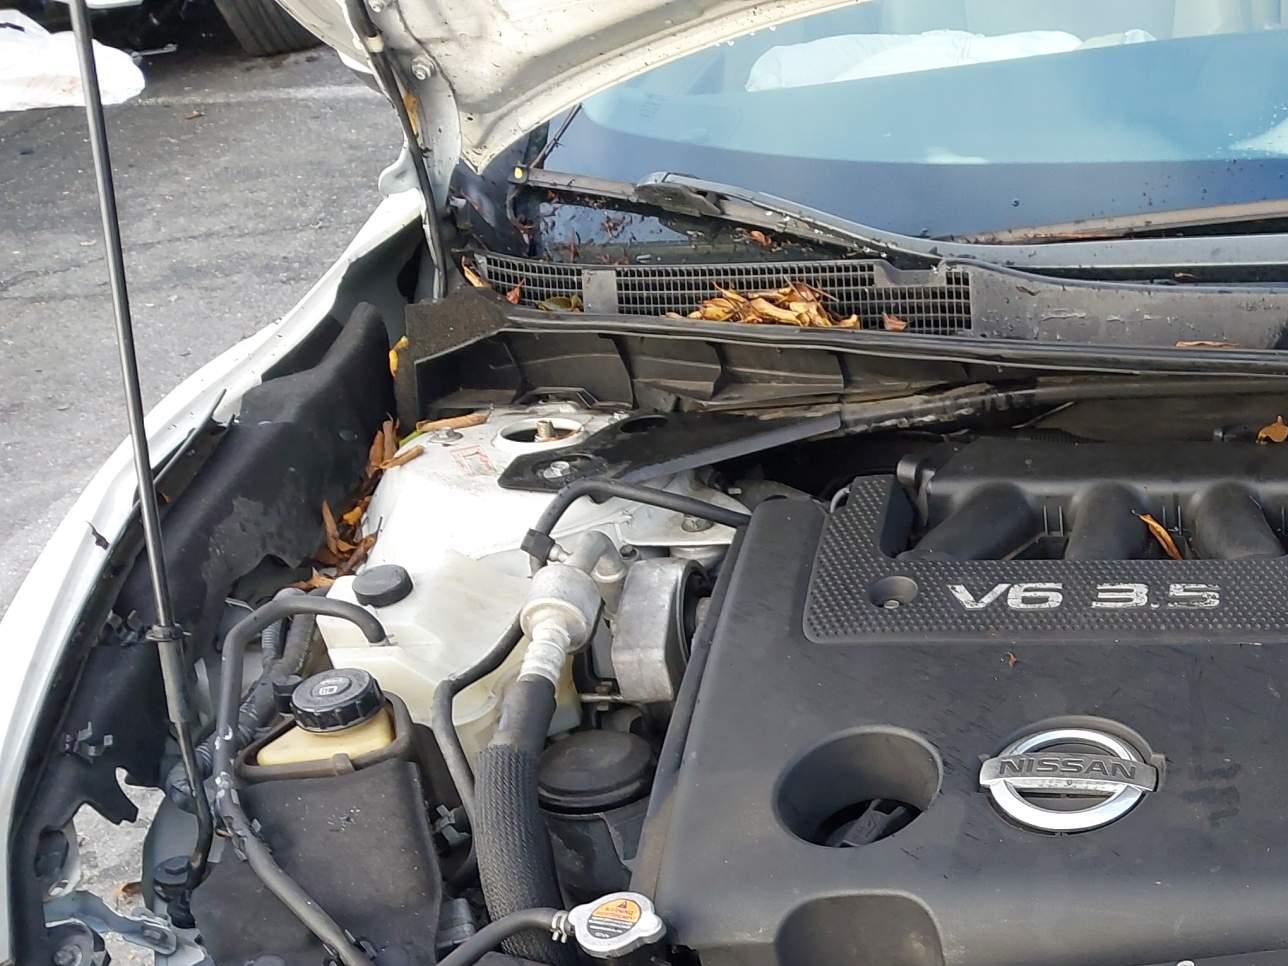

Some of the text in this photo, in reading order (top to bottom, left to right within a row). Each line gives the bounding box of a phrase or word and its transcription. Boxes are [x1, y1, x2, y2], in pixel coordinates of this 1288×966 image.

[947, 583, 1221, 609] V6 3.5
[1000, 757, 1137, 780] NISSAN
